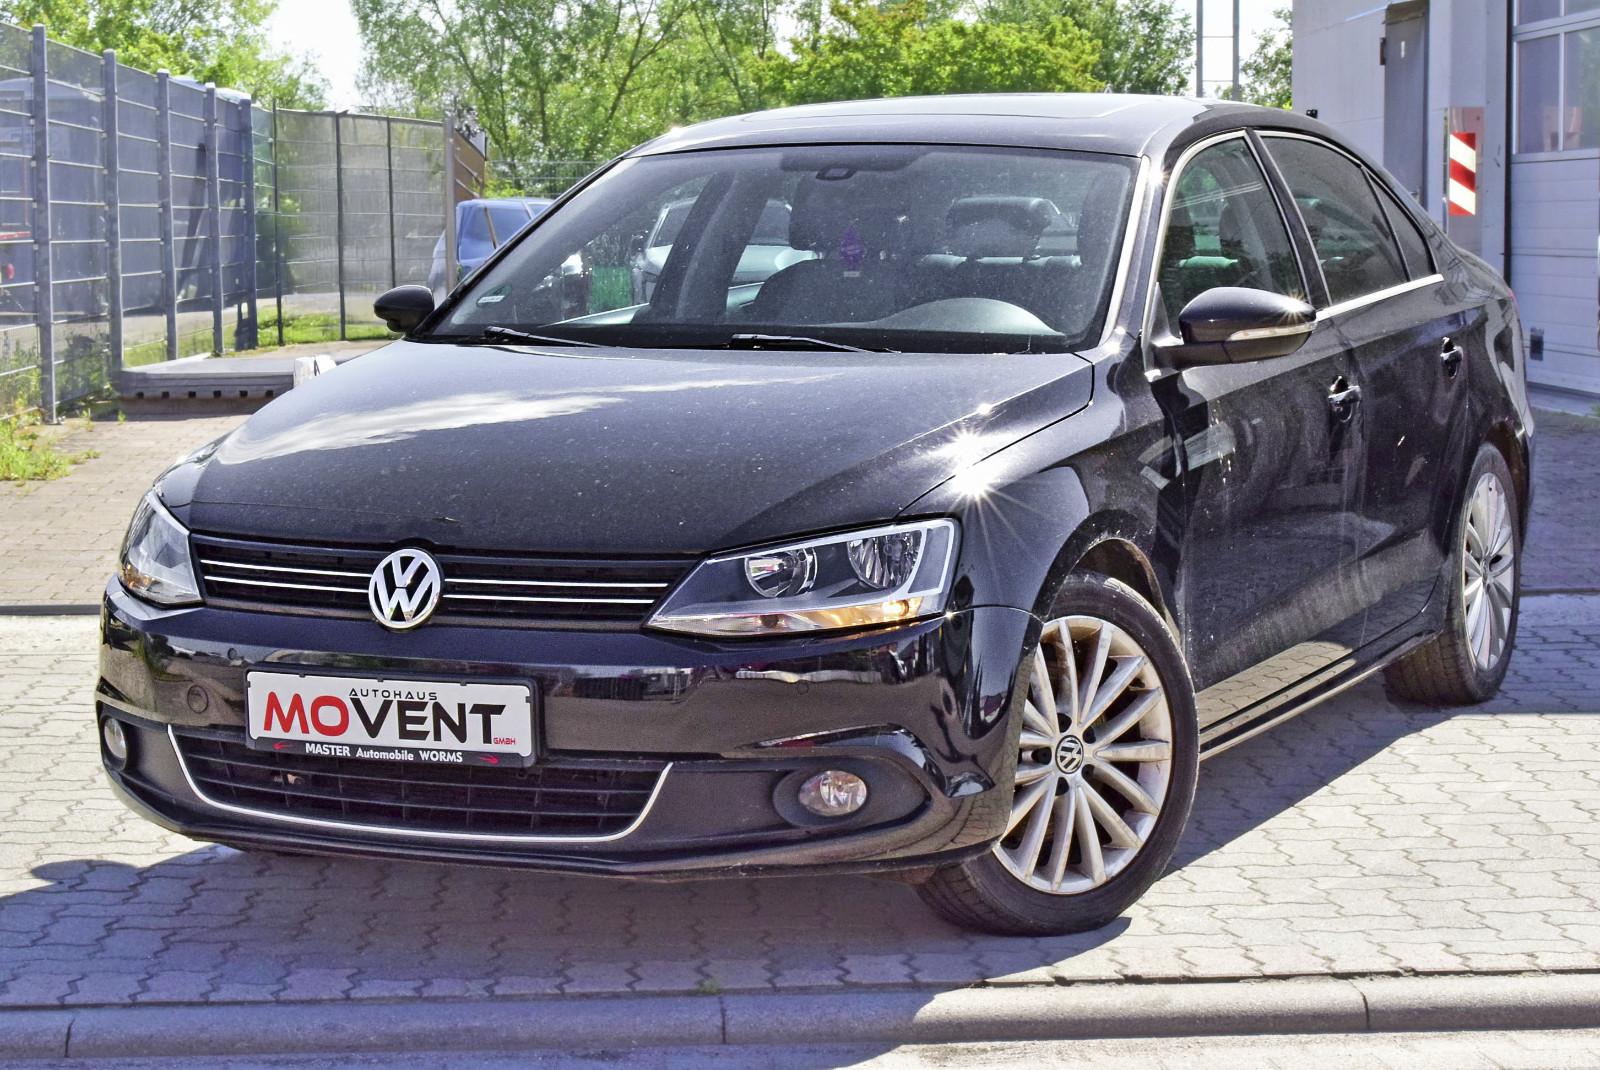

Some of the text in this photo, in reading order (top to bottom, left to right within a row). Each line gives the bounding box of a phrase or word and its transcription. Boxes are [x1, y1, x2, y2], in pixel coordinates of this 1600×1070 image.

[369, 549, 440, 628] VW
[349, 687, 438, 701] AUTOHAUS
[263, 691, 506, 745] MOVENT
[305, 742, 463, 763] MASTER Automobile WORMS
